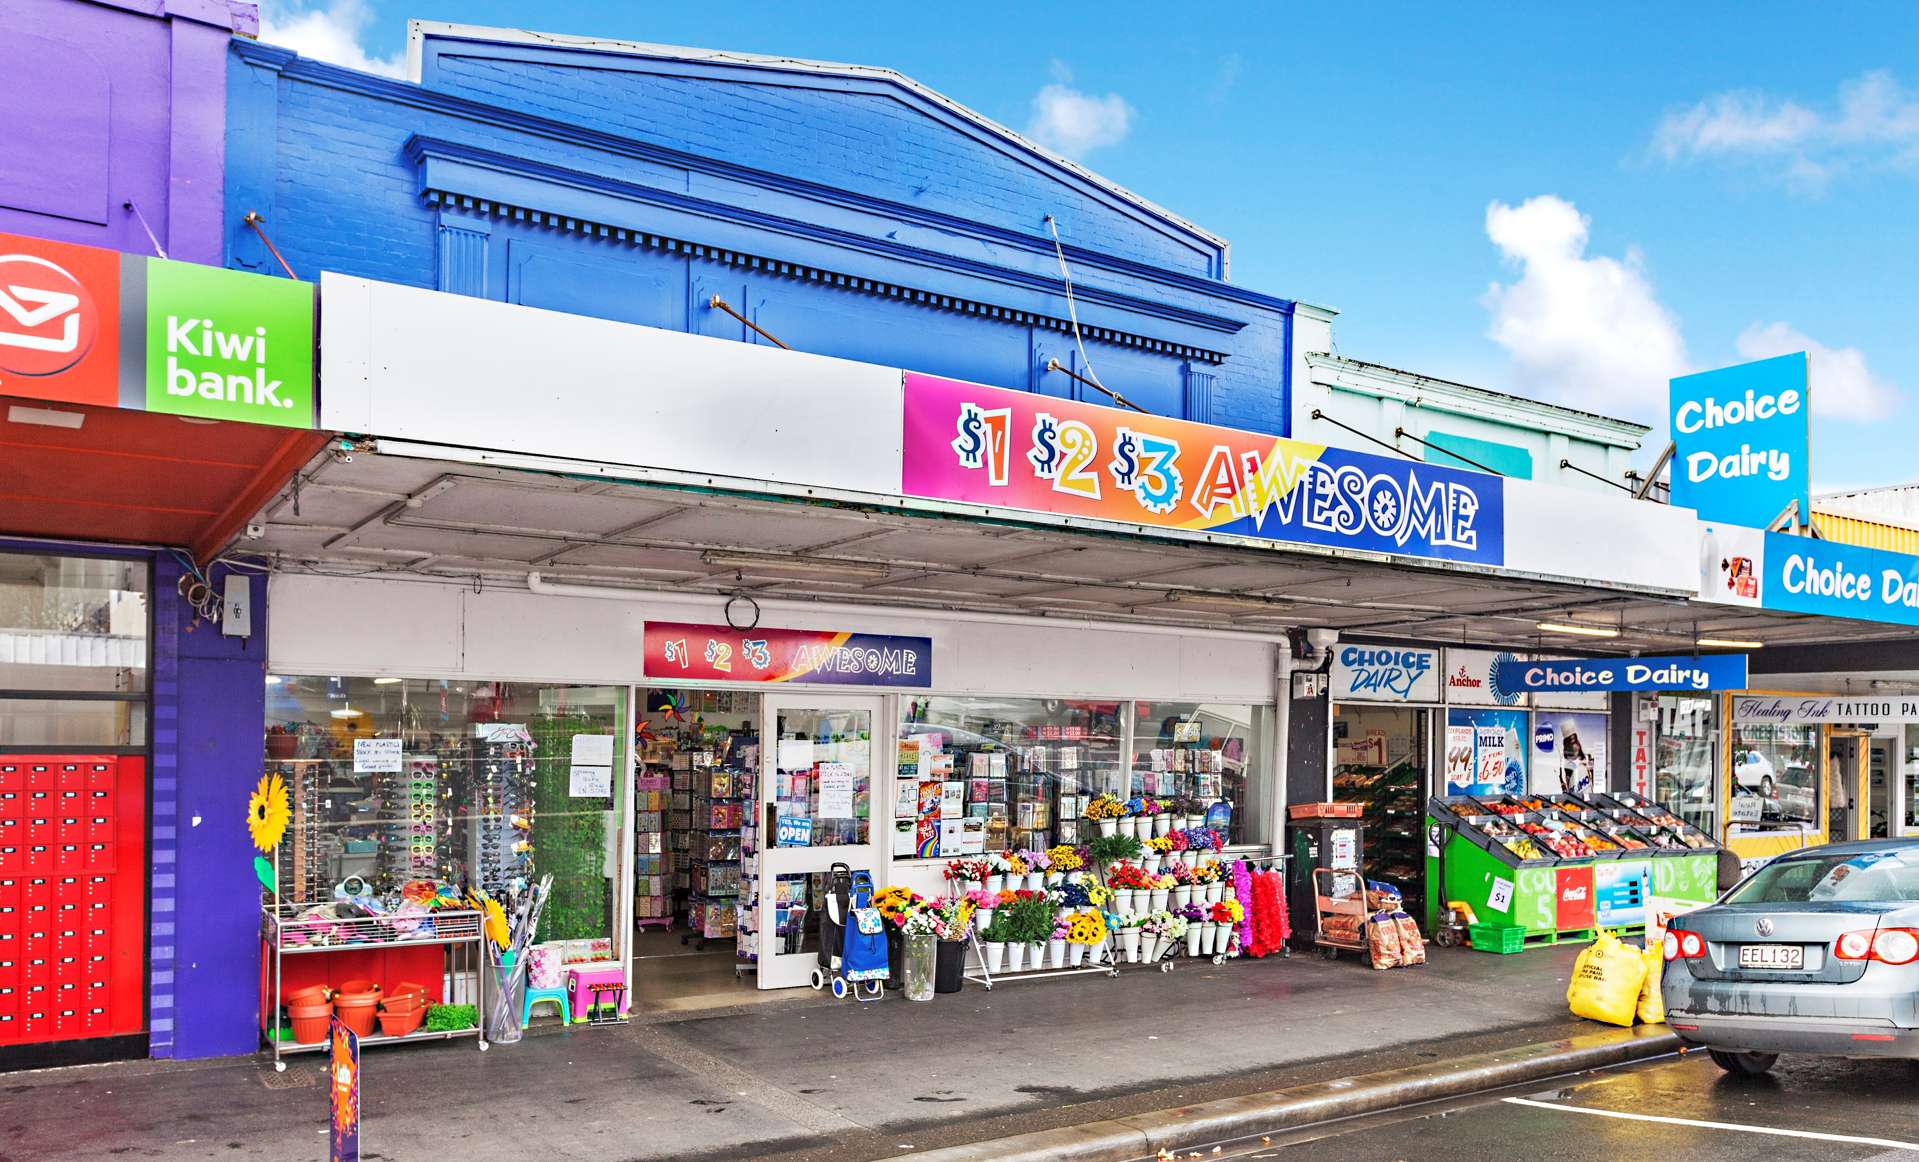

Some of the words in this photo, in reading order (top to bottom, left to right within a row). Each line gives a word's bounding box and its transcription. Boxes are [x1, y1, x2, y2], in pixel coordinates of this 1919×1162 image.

[167, 315, 266, 364] Kiwi
[167, 356, 294, 409] bank.
[1675, 389, 1800, 433] Choice
[952, 403, 1011, 486] $1
[1026, 413, 1101, 500] $2
[1108, 427, 1183, 514] $3
[1190, 445, 1480, 551] AWESOME
[1686, 444, 1790, 483] Dairy
[1782, 554, 1872, 601] Choice
[664, 639, 689, 669] $1
[705, 639, 733, 672] $2
[742, 638, 771, 669] $3
[791, 645, 917, 676] AWESOME
[1340, 646, 1432, 671] CHOICE
[1349, 667, 1425, 699] DAIRY
[1449, 675, 1482, 688] Anchor
[1524, 666, 1614, 687] Choice
[1625, 664, 1709, 689] Dairy
[1738, 699, 1793, 723] Healing
[1797, 699, 1833, 718] Ink
[1836, 702, 1890, 716] TATTOO
[1479, 735, 1505, 748] MILK
[1535, 733, 1554, 744] PRIMO
[779, 826, 810, 842] OPEN
[1741, 948, 1800, 964] EEL132
